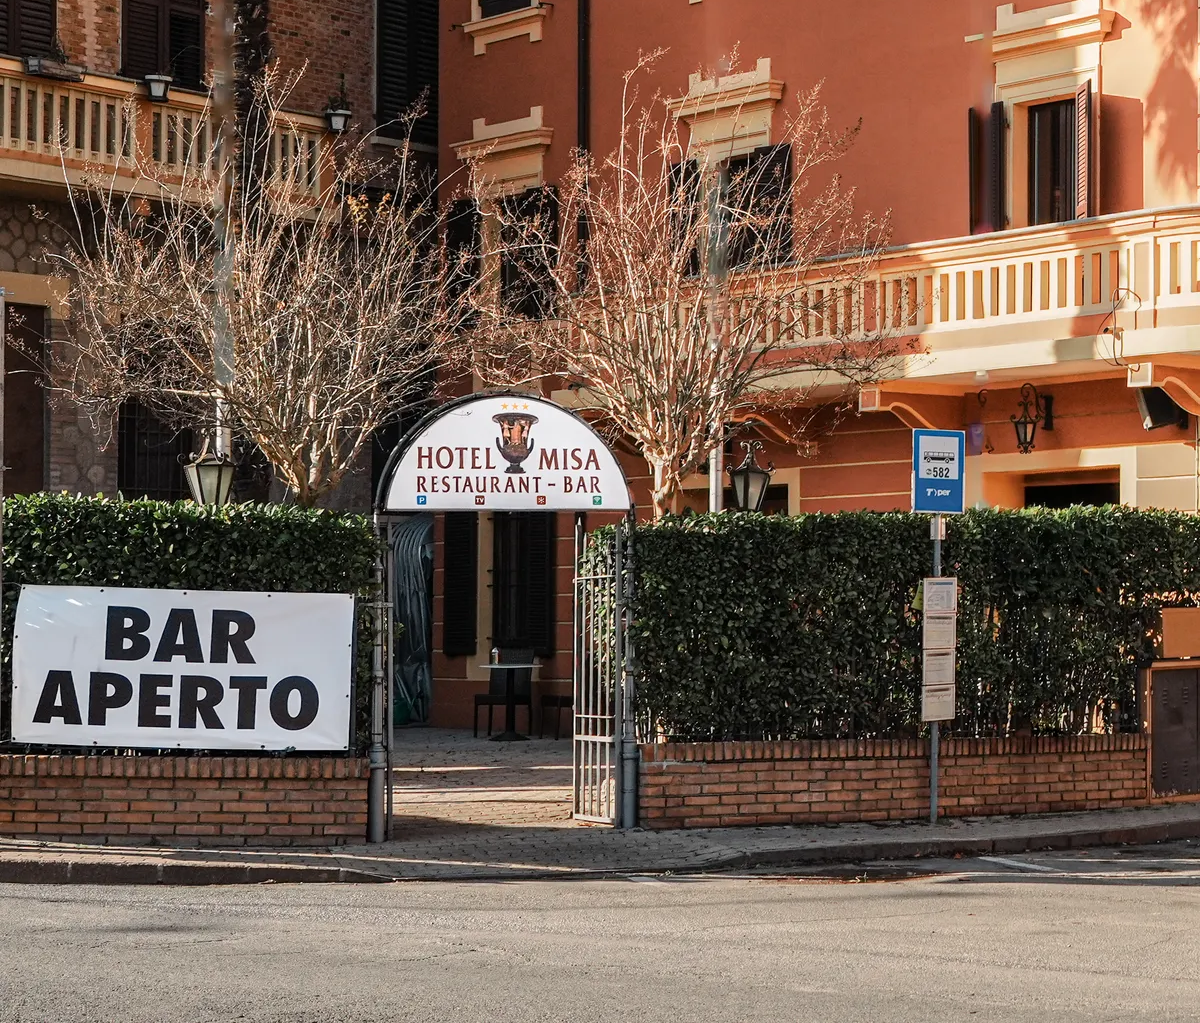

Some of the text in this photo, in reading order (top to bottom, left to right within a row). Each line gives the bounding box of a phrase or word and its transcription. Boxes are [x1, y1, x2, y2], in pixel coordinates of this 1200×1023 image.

[416, 446, 601, 471] HOTEL MISA
[416, 476, 542, 494] RESTAURANT
[563, 476, 602, 494] BAR
[932, 466, 950, 479] 582
[105, 605, 257, 664] BAR
[32, 670, 320, 731] APERTO
